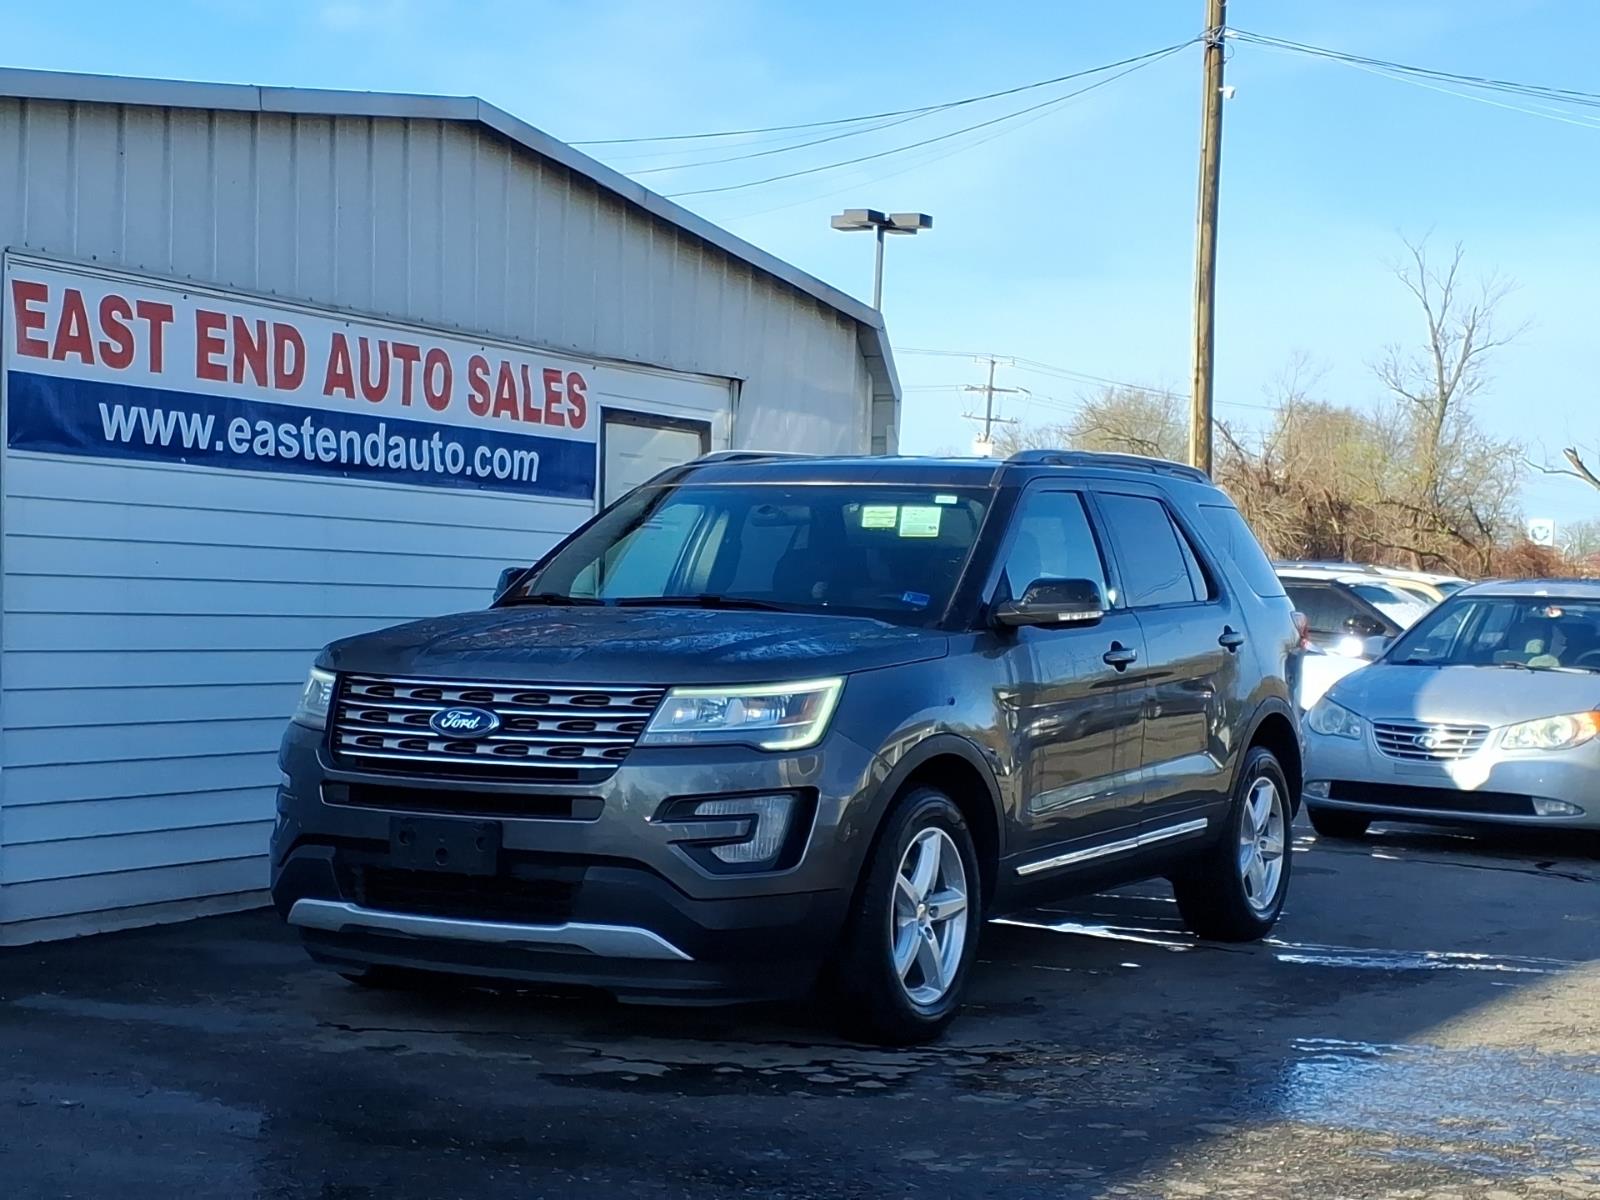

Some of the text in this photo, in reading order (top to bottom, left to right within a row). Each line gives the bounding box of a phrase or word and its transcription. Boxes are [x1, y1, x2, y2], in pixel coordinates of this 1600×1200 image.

[11, 280, 588, 430] EAST END AUTO SALES
[98, 402, 540, 482] www.eastendauto.com
[440, 711, 481, 730] Ford
